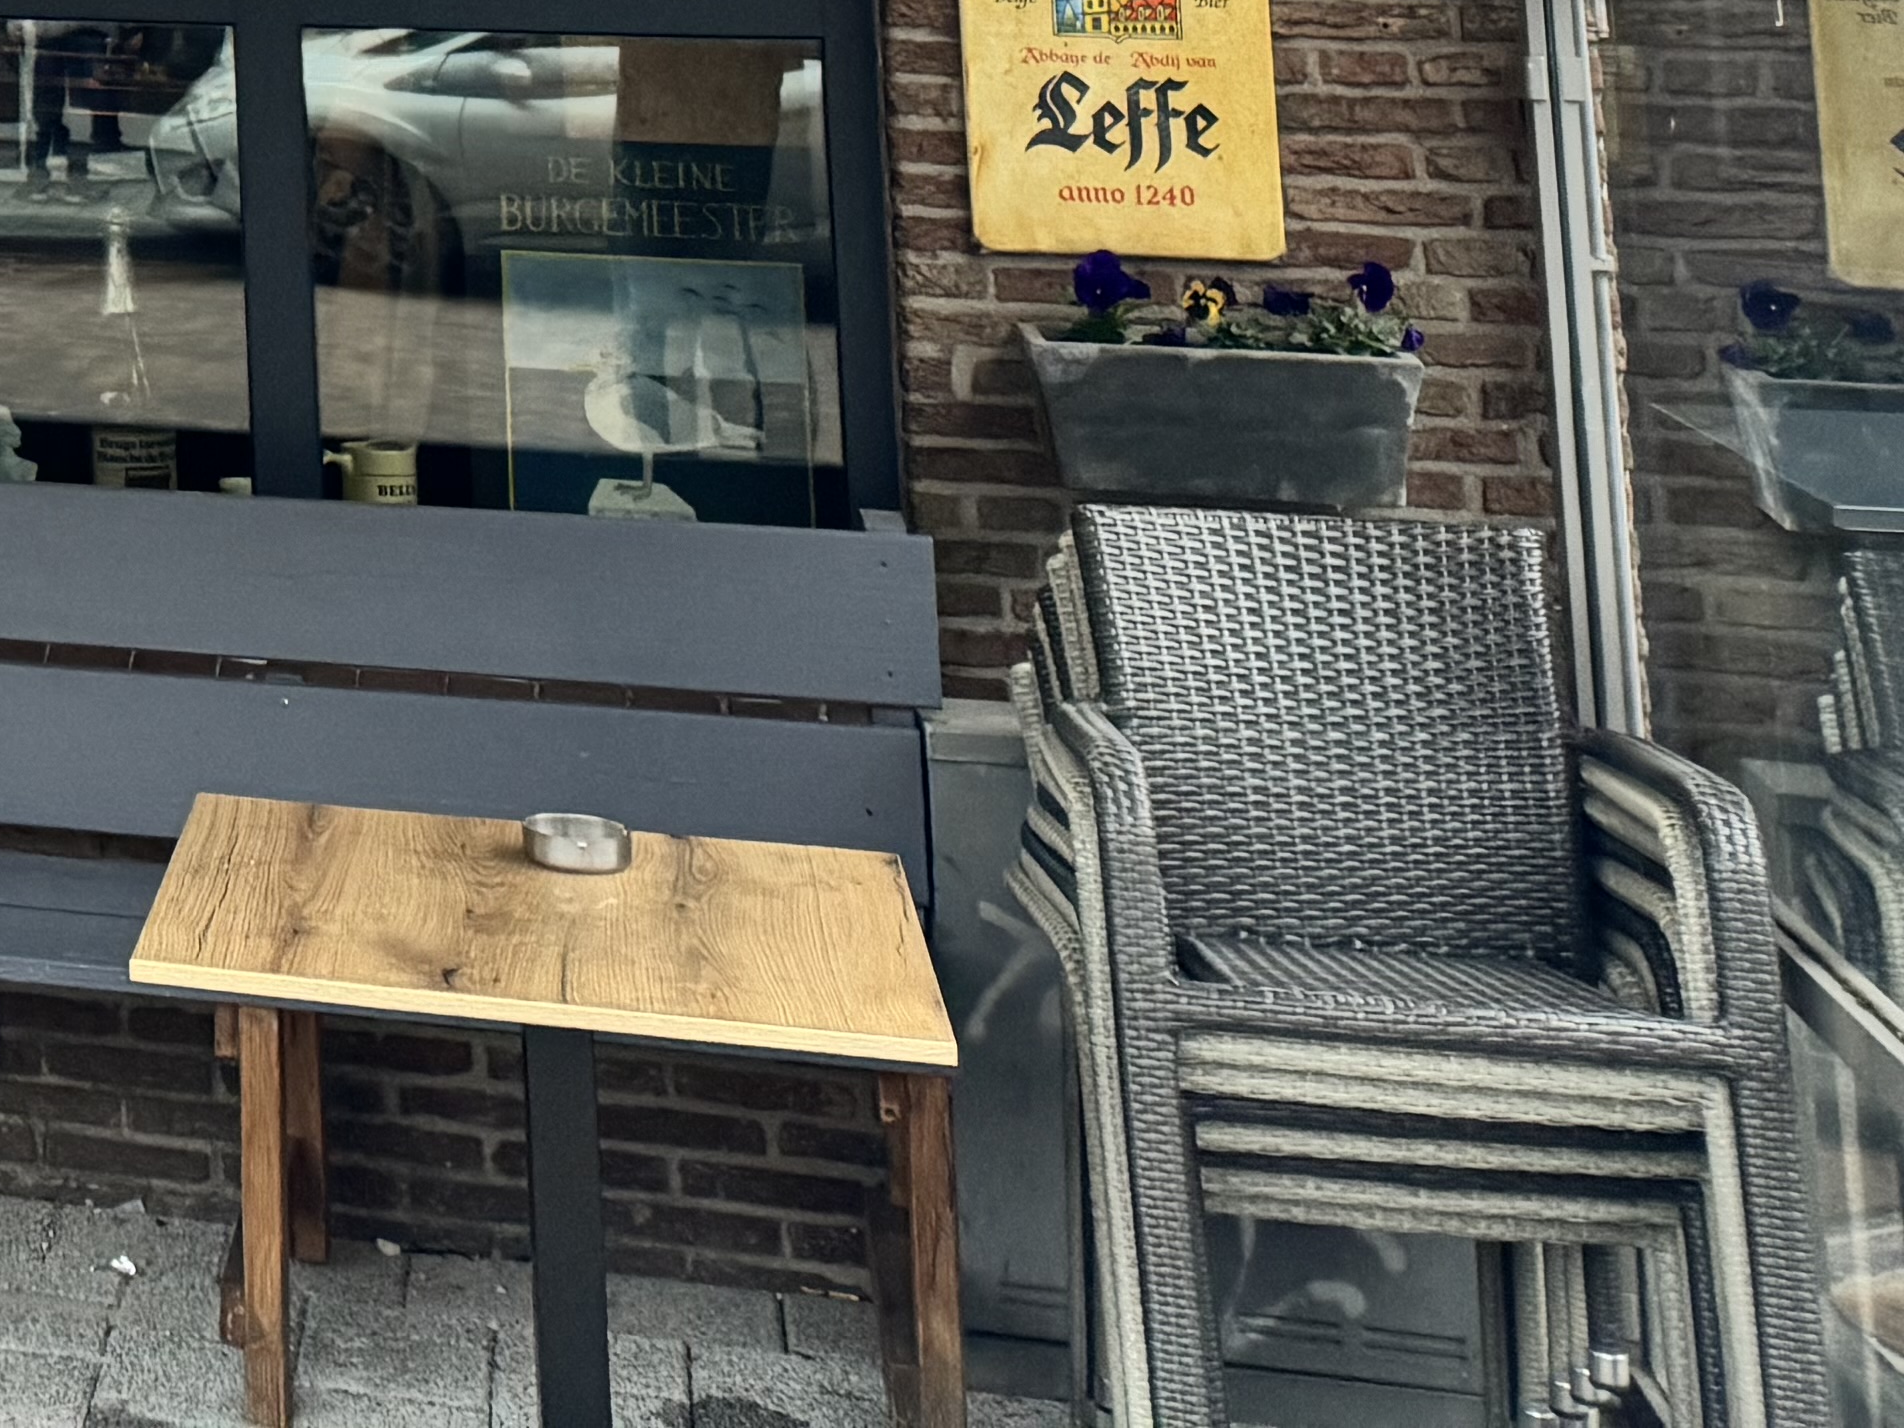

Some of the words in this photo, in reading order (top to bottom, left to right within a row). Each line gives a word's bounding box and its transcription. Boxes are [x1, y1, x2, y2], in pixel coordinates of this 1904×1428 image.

[1020, 46, 1088, 68] Abbaye
[1093, 51, 1111, 65] de
[1130, 51, 1181, 71] Abdij
[1186, 56, 1217, 70] van
[1024, 70, 1221, 174] Leffe
[548, 155, 592, 185] DE
[608, 158, 737, 193] KLEINE
[1058, 184, 1125, 205] anno
[1135, 184, 1196, 207] 1240
[499, 191, 799, 245] BURGEMEESTER
